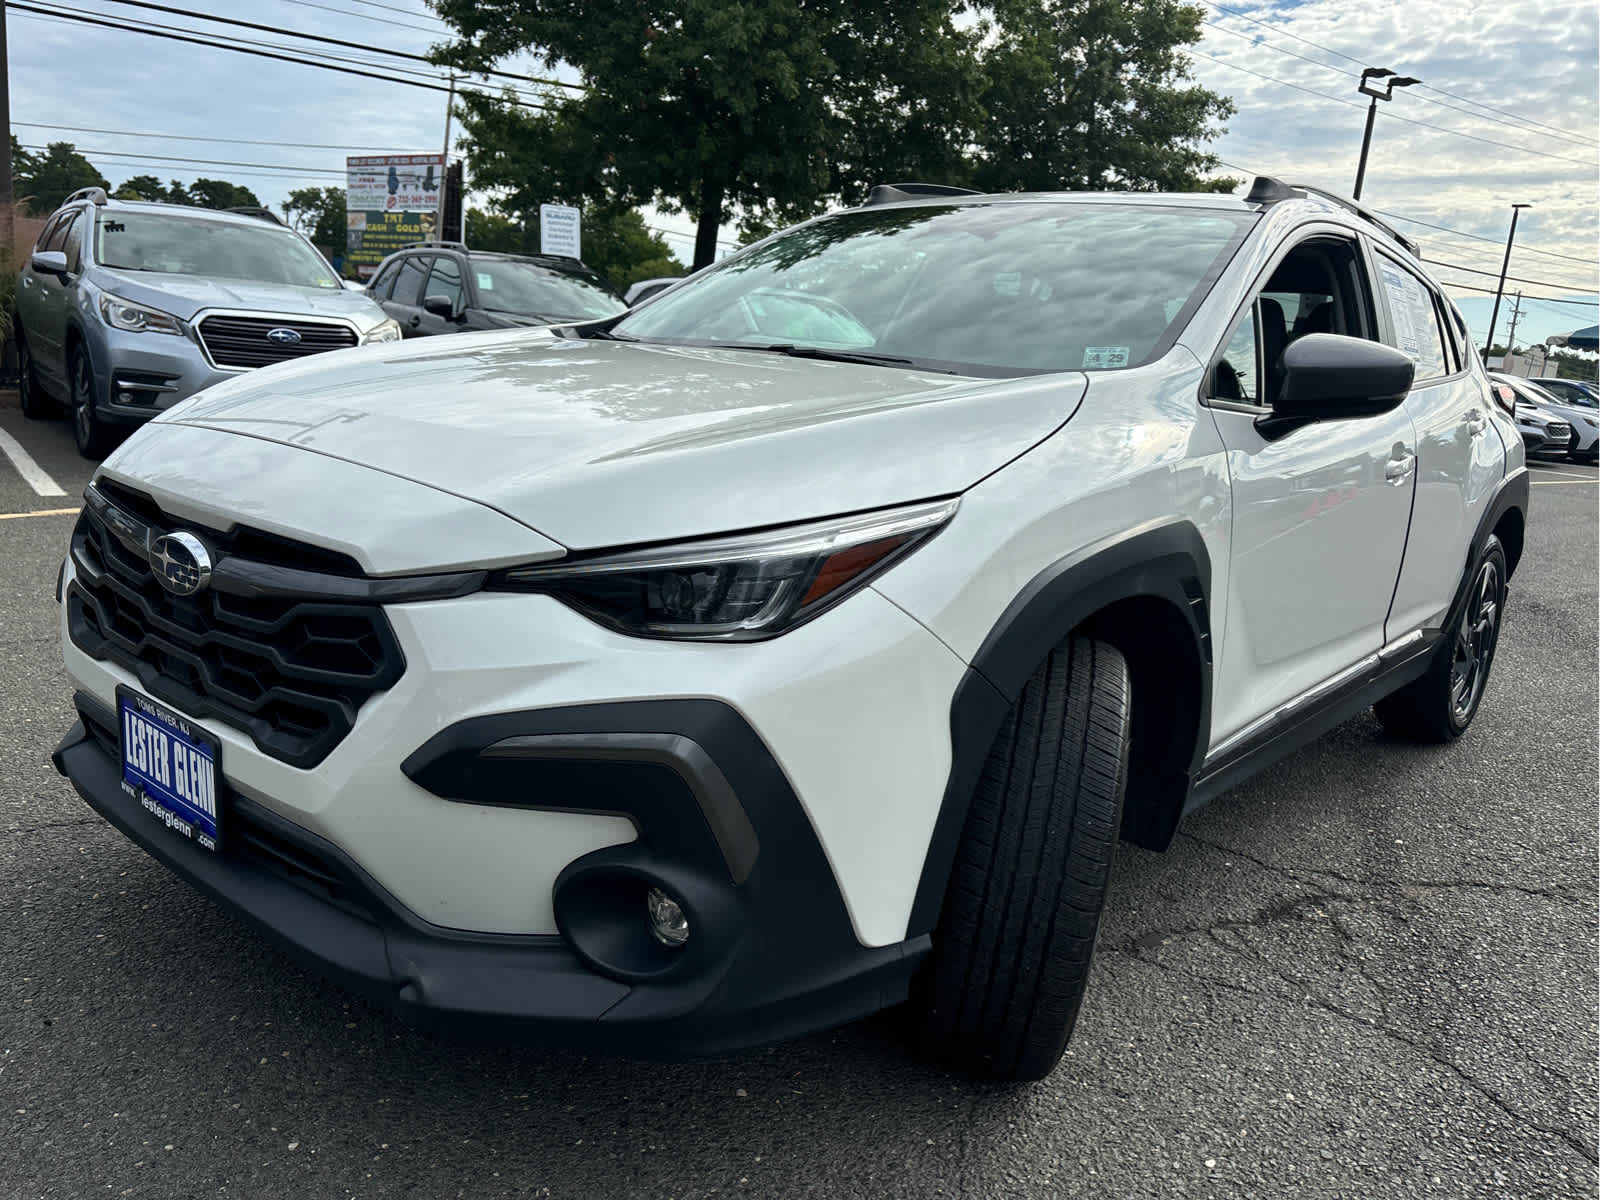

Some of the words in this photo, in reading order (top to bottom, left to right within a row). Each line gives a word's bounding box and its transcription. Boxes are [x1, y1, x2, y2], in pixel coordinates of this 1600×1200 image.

[367, 223, 388, 232] CASH
[396, 223, 420, 233] GOLD
[384, 213, 404, 223] TMT
[1108, 353, 1124, 362] 29
[136, 697, 157, 718] TOMS
[180, 719, 190, 736] NJ
[124, 711, 170, 789] LESTER
[174, 740, 216, 819] GLENN
[141, 791, 192, 838] lesterglenn
